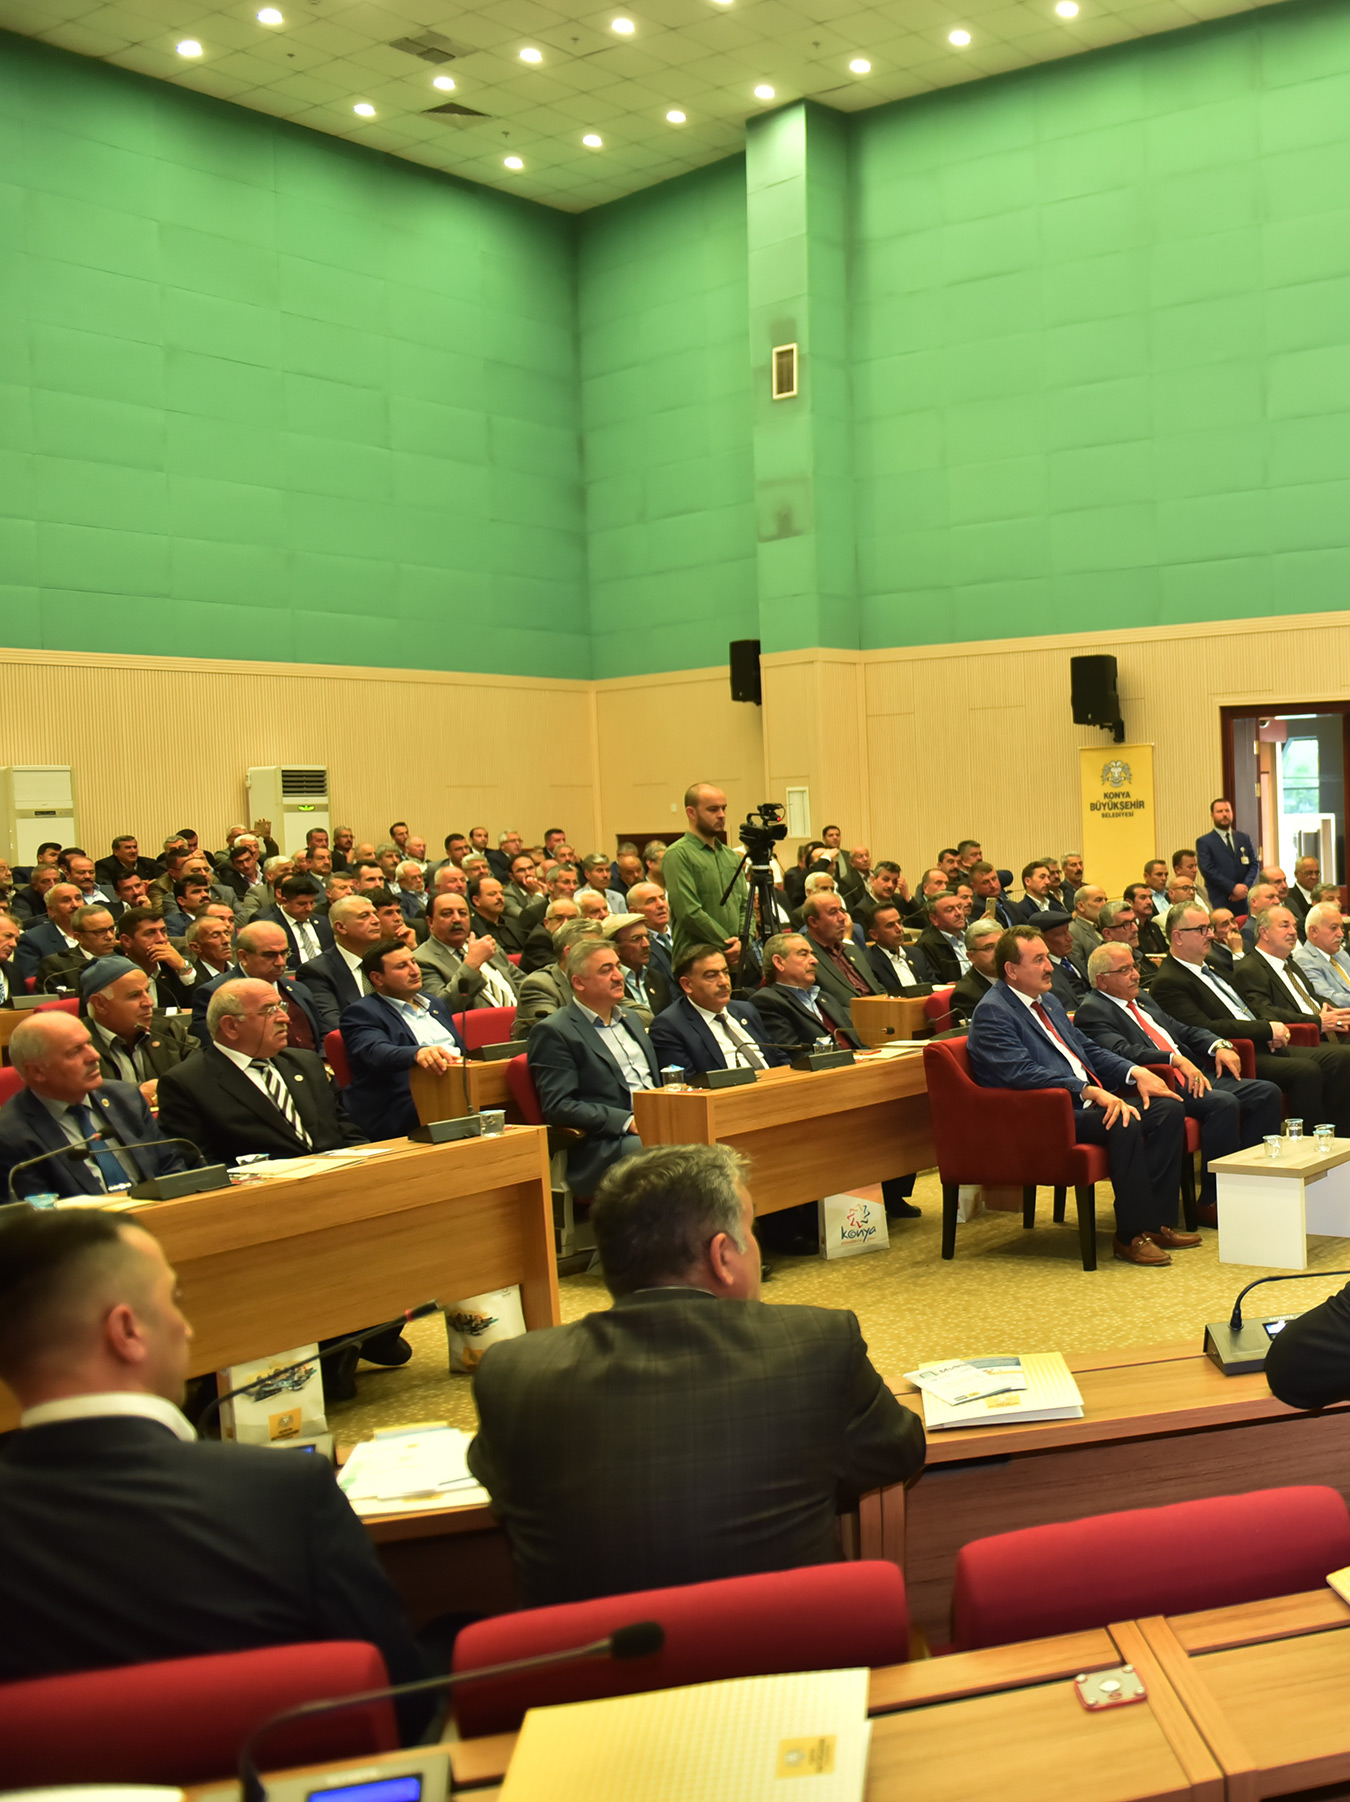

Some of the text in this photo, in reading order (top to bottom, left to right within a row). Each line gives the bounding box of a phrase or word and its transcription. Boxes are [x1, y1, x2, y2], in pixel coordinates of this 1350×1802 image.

[1103, 791, 1131, 800] KONYA
[1090, 799, 1145, 811] BÜYÜKŞEHİR
[841, 1226, 876, 1243] konya
